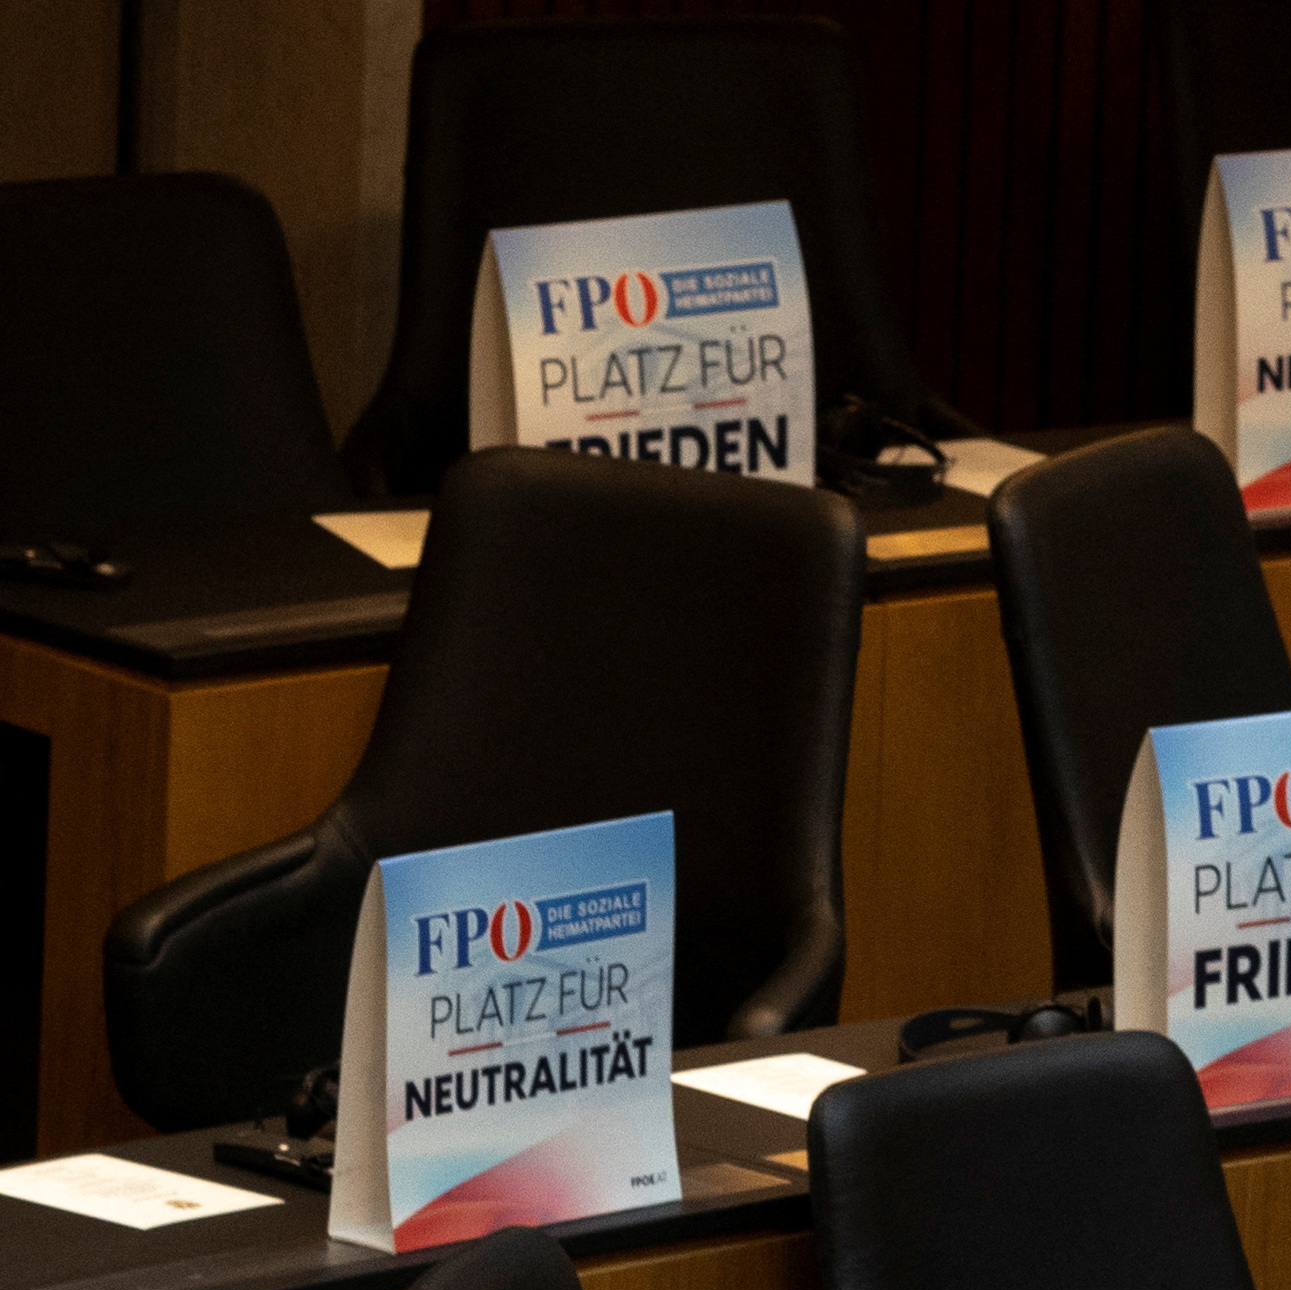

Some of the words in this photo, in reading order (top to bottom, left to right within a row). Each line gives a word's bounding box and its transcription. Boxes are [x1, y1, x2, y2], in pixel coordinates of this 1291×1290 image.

[541, 345, 687, 406] PLATZ
[700, 325, 788, 388] FÜR
[431, 978, 547, 1039] PLATZ
[560, 956, 629, 1016] FÜR
[404, 1030, 652, 1121] NEUTRALITÄT
